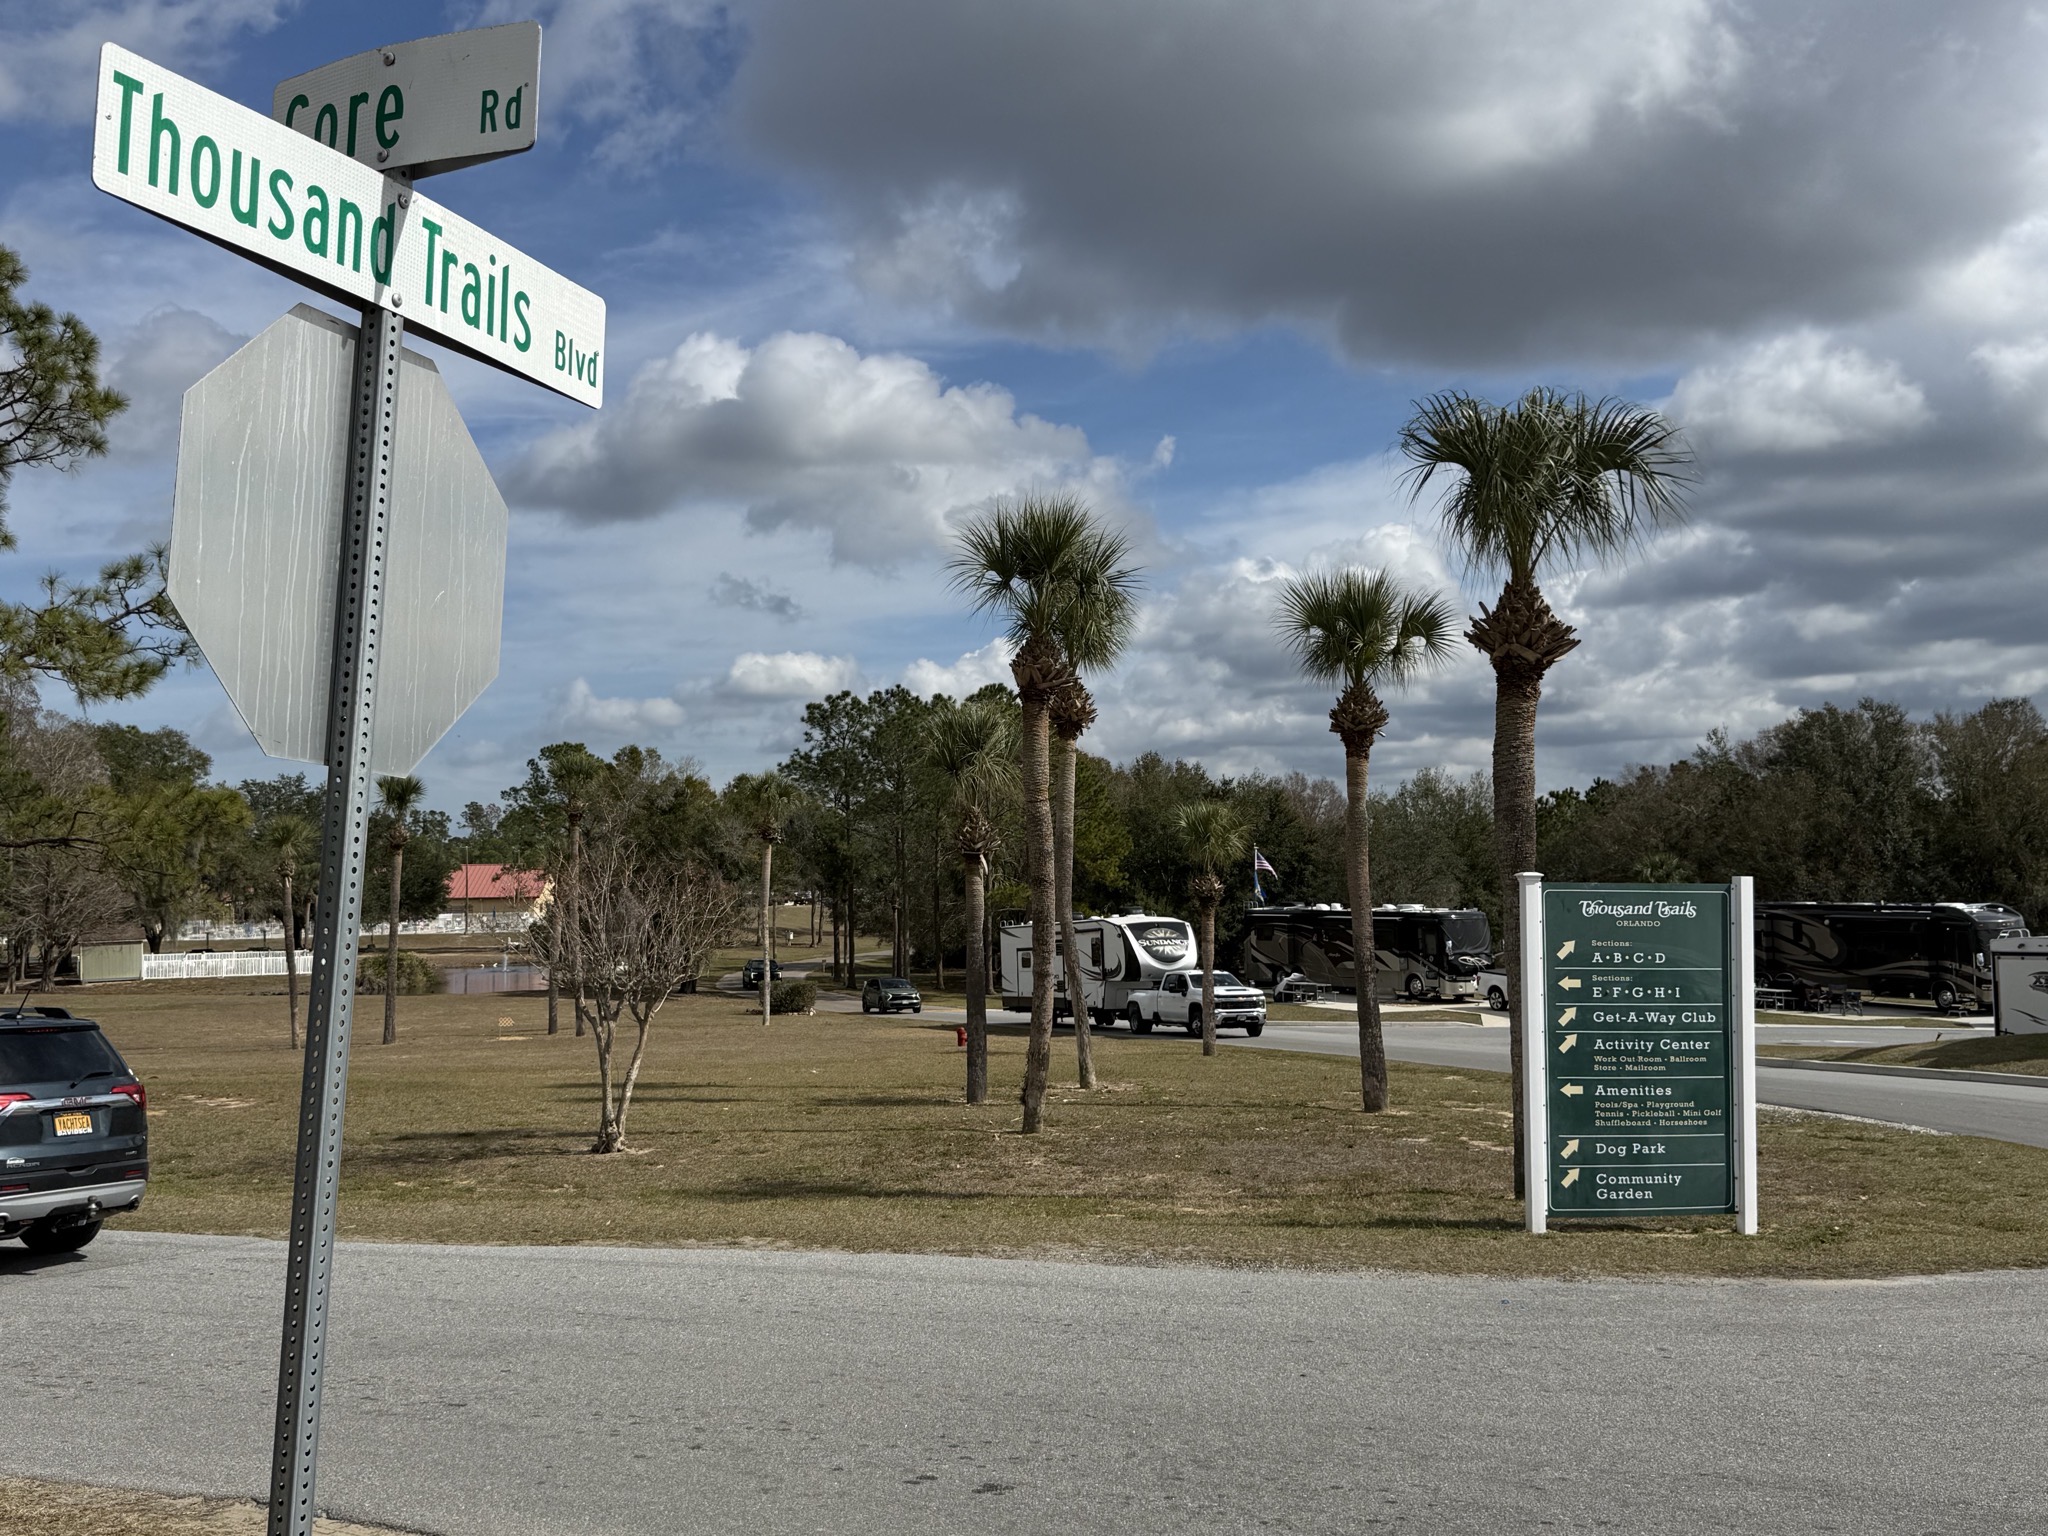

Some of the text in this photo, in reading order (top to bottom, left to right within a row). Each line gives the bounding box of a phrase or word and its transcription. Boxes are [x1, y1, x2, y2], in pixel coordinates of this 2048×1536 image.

[480, 87, 522, 134] Rd
[113, 70, 598, 388] Thousand Trails Blvd
[1579, 900, 1697, 918] Thousand Trails
[1592, 952, 1666, 963] A B C D
[1592, 974, 1633, 982] Sections:
[1593, 987, 1602, 998] E
[1612, 987, 1622, 998] F
[1632, 987, 1644, 998] G
[1655, 987, 1665, 998] H
[1593, 1012, 1716, 1025] Get-A-Way Club
[1593, 1039, 1710, 1052] Activity Center
[1595, 1085, 1672, 1096] Amenities
[1595, 1101, 1695, 1109] Pools/Spa Playground
[57, 1116, 90, 1130] YACHTSEA
[1659, 1118, 1707, 1126] Horseshoes
[1596, 1143, 1666, 1156] Dog Park
[1596, 1173, 1682, 1186] Community
[1596, 1188, 1653, 1199] Garden
